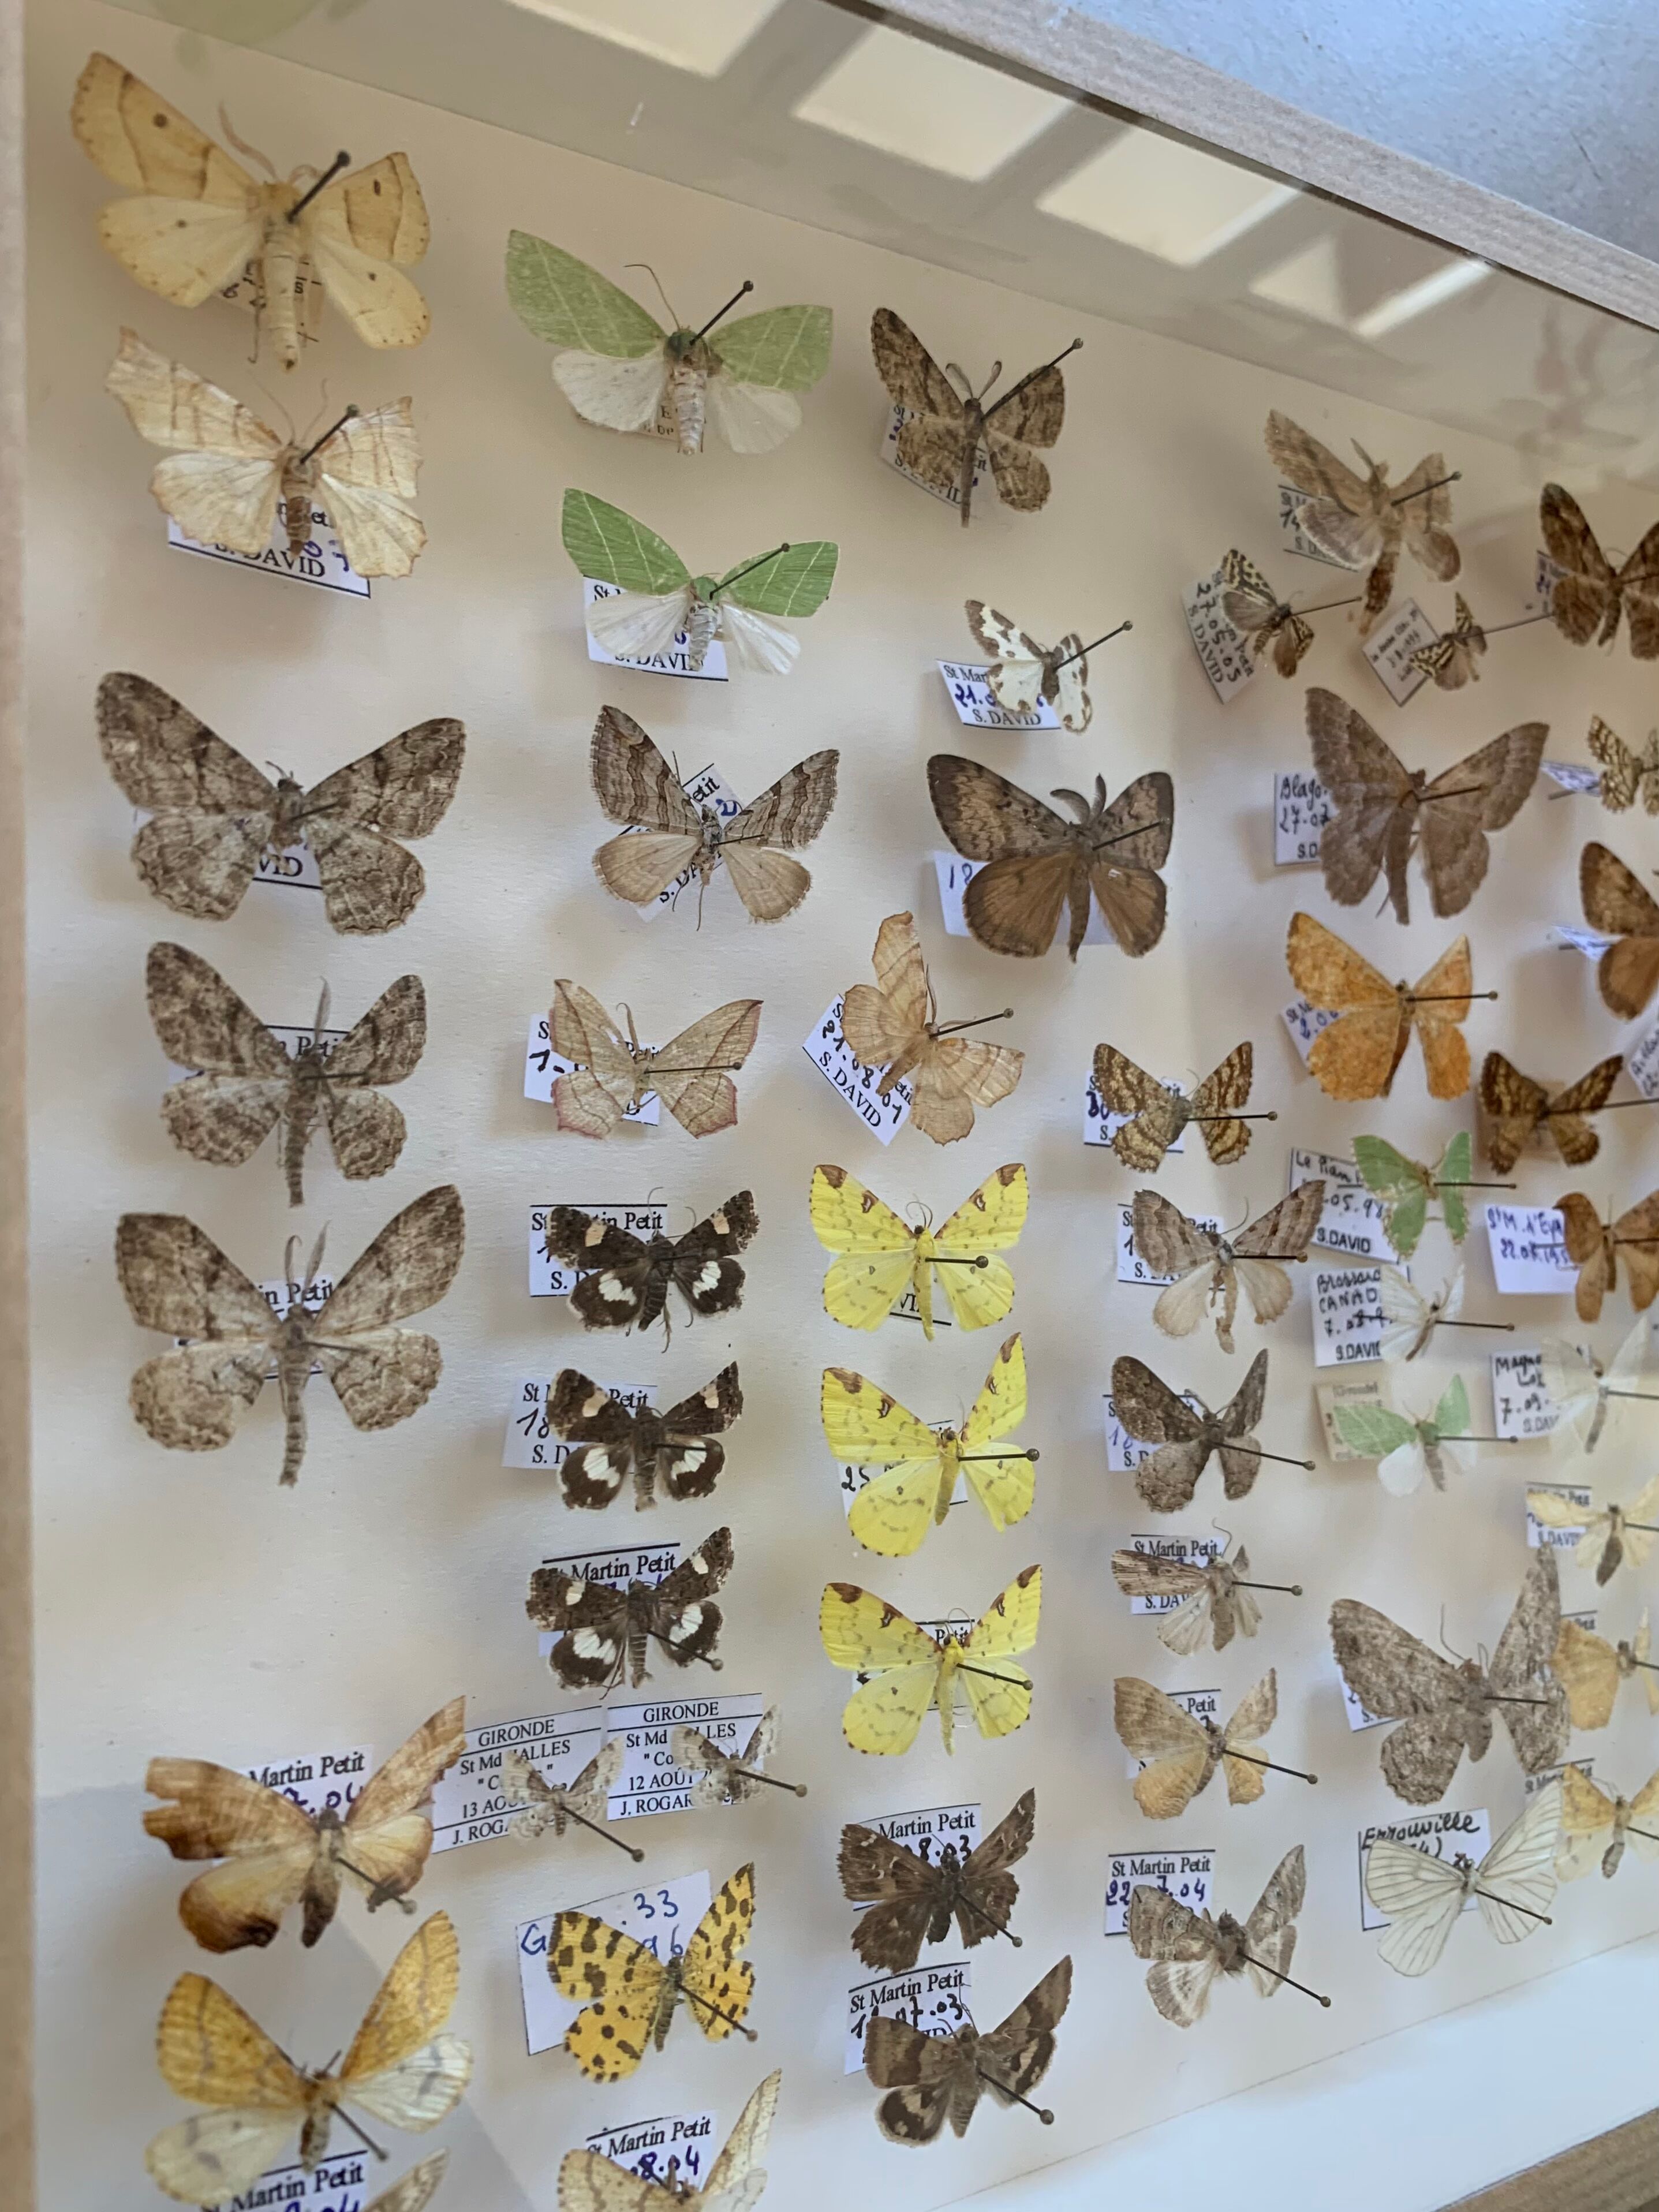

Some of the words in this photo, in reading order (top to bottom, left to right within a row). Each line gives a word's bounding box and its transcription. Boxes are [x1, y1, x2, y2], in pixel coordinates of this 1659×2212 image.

[1193, 623, 1224, 683] DAVID
[943, 665, 958, 679] St
[959, 668, 988, 683] Mar
[972, 708, 987, 724] S.
[987, 710, 1041, 726] DAVID
[692, 776, 720, 804] etit
[258, 853, 304, 877] VID
[819, 1051, 832, 1072] S.
[832, 1066, 881, 1127] DAVID
[624, 1210, 663, 1231] Petit
[1134, 1261, 1147, 1279] S.
[551, 1271, 568, 1290] S.
[523, 1383, 539, 1403] St
[532, 1444, 548, 1464] S.
[1123, 1450, 1135, 1467] S.
[1148, 1538, 1187, 1556] Martin
[1190, 1539, 1218, 1557] Petit
[571, 1557, 630, 1582] Martin
[636, 1551, 676, 1575] Petit
[1145, 1594, 1156, 1609] S.
[643, 1702, 719, 1723] GIRONDE
[1187, 1695, 1216, 1713] Petit
[479, 1719, 555, 1747] GIRONDE
[626, 1733, 641, 1748] St
[644, 1729, 668, 1746] Md
[459, 1759, 474, 1776] St
[479, 1752, 503, 1772] Md
[513, 1739, 571, 1761] ALLES
[249, 1759, 313, 1788] Martin
[319, 1751, 366, 1778] Petit
[629, 1776, 645, 1791] 12
[462, 1804, 479, 1818] 13
[620, 1800, 632, 1816] J.
[879, 1816, 932, 1839] Martin
[937, 1810, 976, 1832] Petit
[452, 1830, 464, 1845] J.
[1111, 1860, 1126, 1877] St
[1129, 1856, 1175, 1875] Martin
[1180, 1855, 1211, 1873] Petit
[850, 1994, 866, 2014] St
[869, 1978, 922, 2007] Martin
[926, 1968, 964, 1993] Petit
[607, 2125, 666, 2158] Martin
[670, 2116, 712, 2142] Petit
[231, 2174, 306, 2211] Martin
[313, 2161, 365, 2194] Petit
